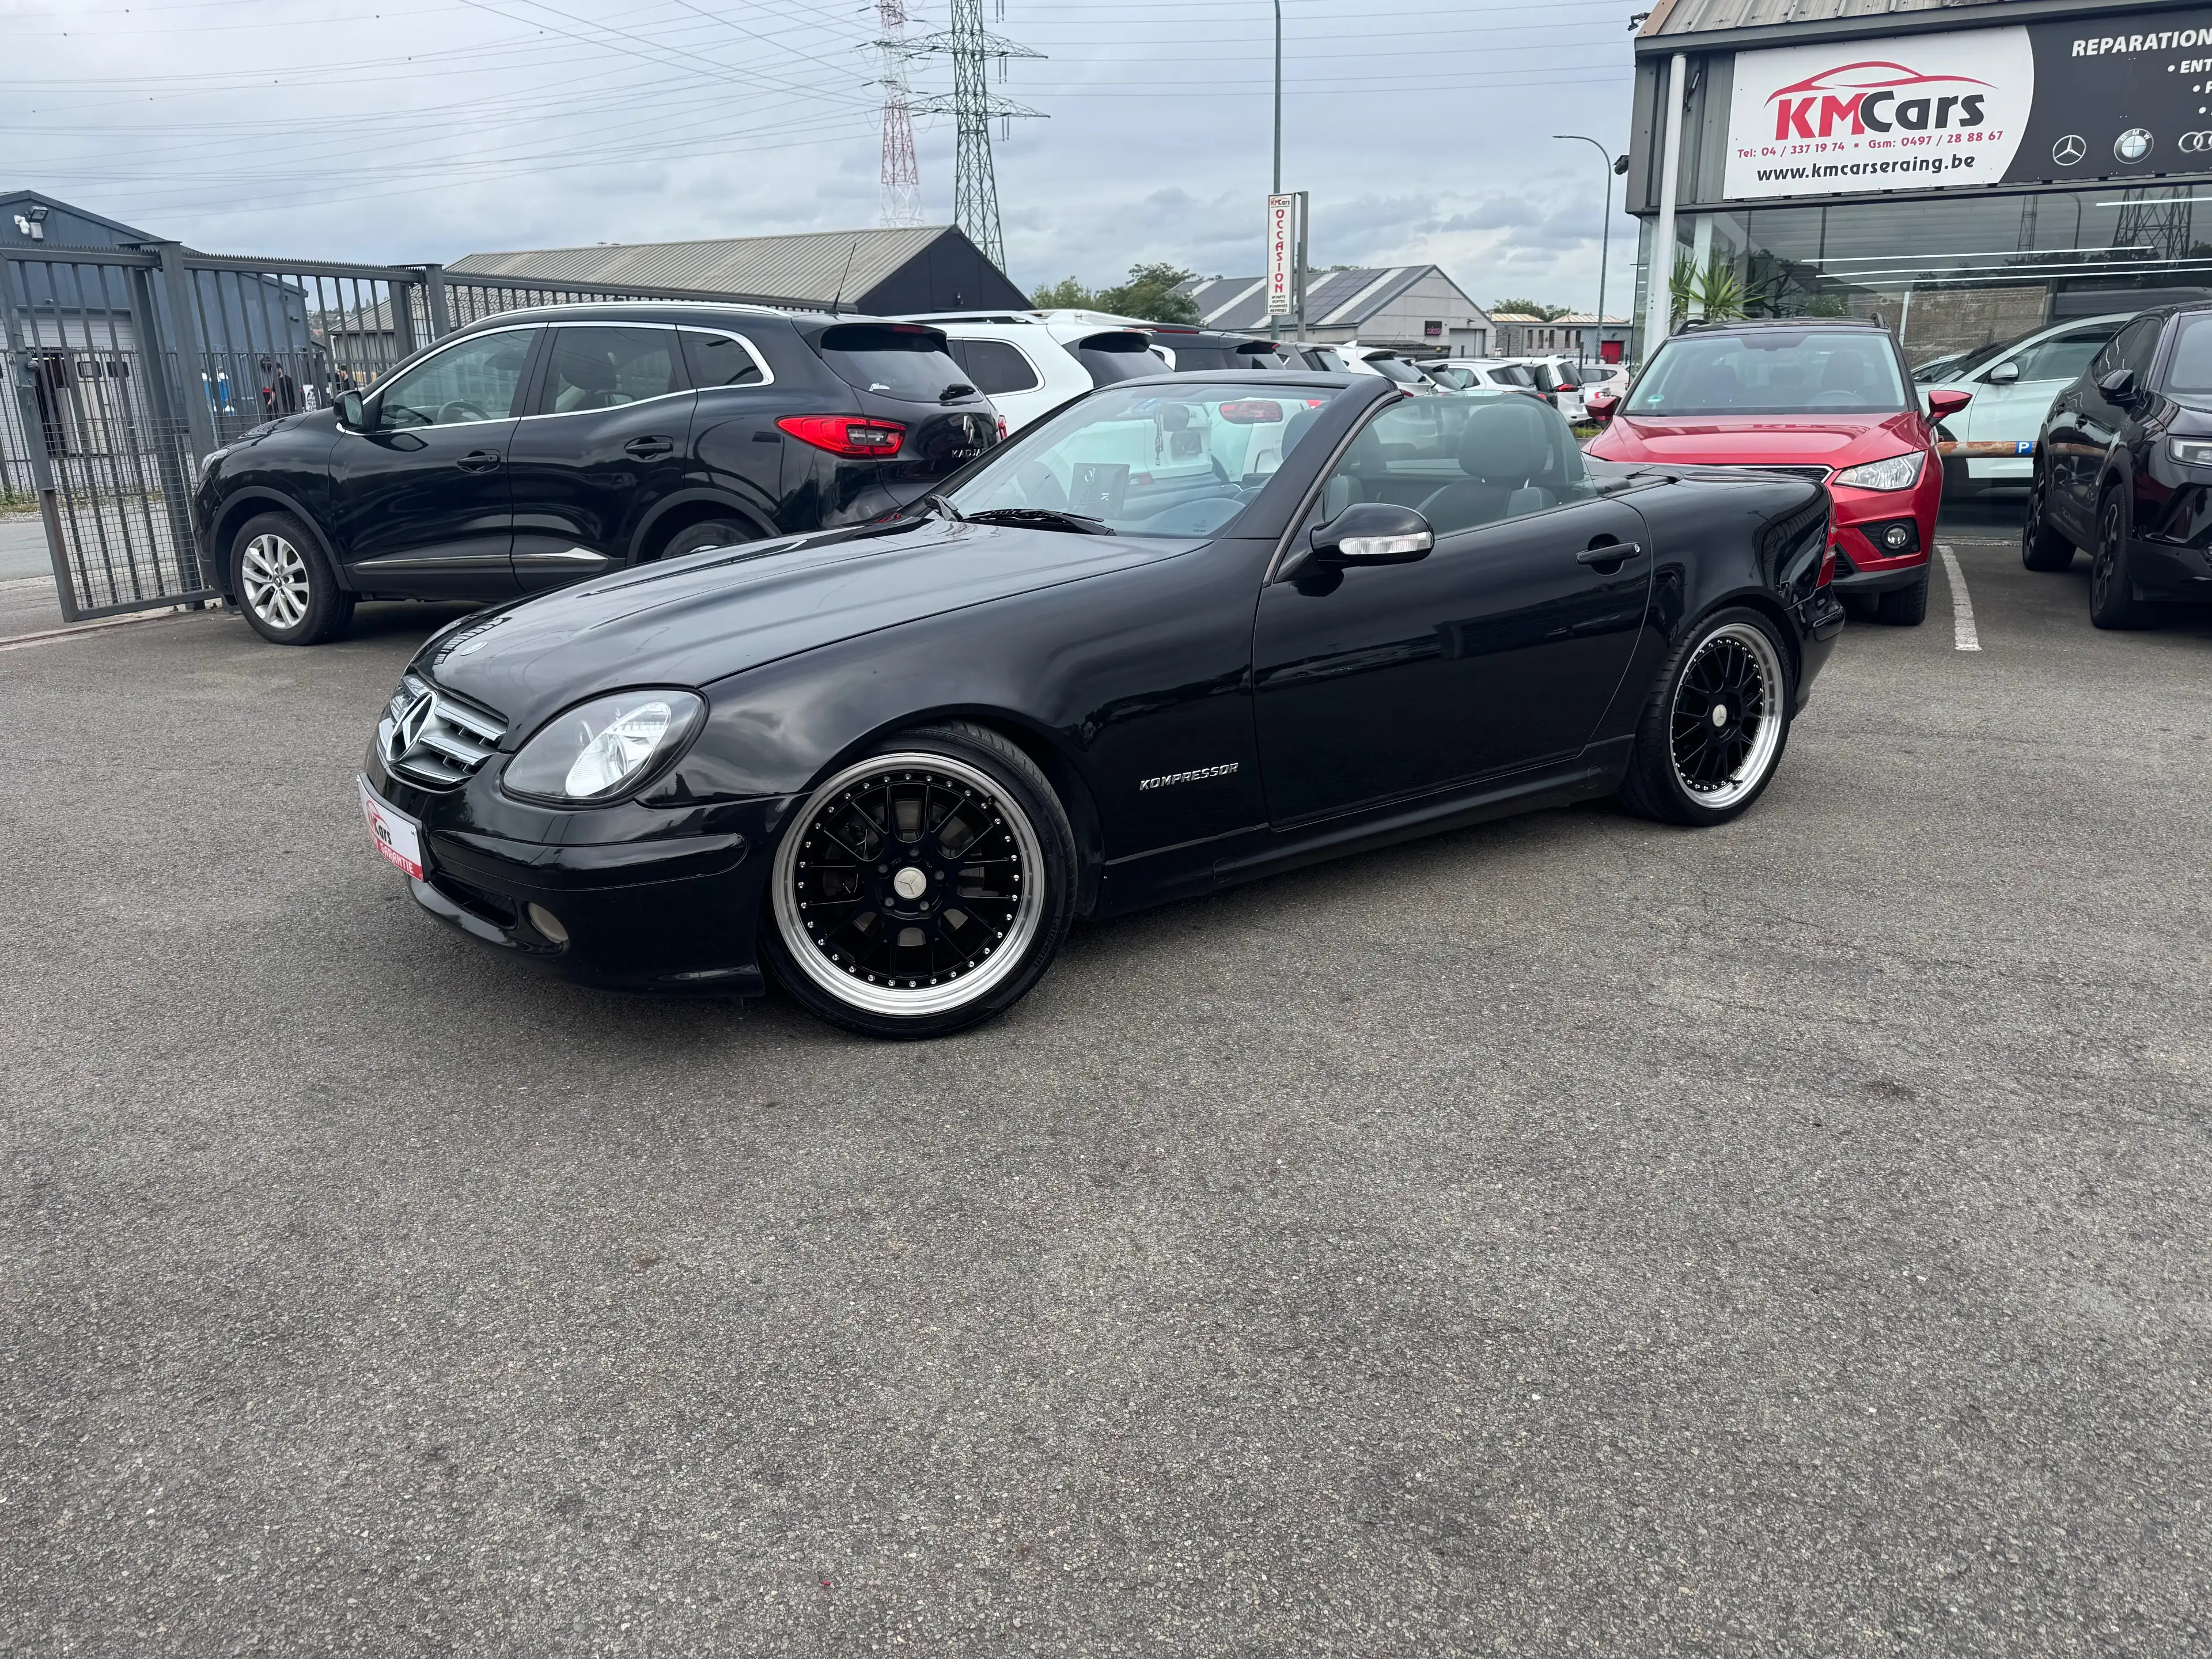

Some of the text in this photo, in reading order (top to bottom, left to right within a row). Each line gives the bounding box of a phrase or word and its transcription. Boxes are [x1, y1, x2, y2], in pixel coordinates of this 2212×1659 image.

[2072, 28, 2212, 56] REPARATION
[1775, 90, 1984, 141] KMCars
[1737, 131, 2003, 158] Tel: 04 / 337 19 74 Gsm: 0497 / 28 88 67
[2120, 130, 2150, 141] BMW
[1757, 154, 1975, 181] www.kmcarseraing.be
[1275, 209, 1285, 293] OCCASION
[2018, 442, 2029, 453] P
[1139, 763, 1238, 790] KOMPRESSOR
[380, 842, 414, 874] GARANTIE
